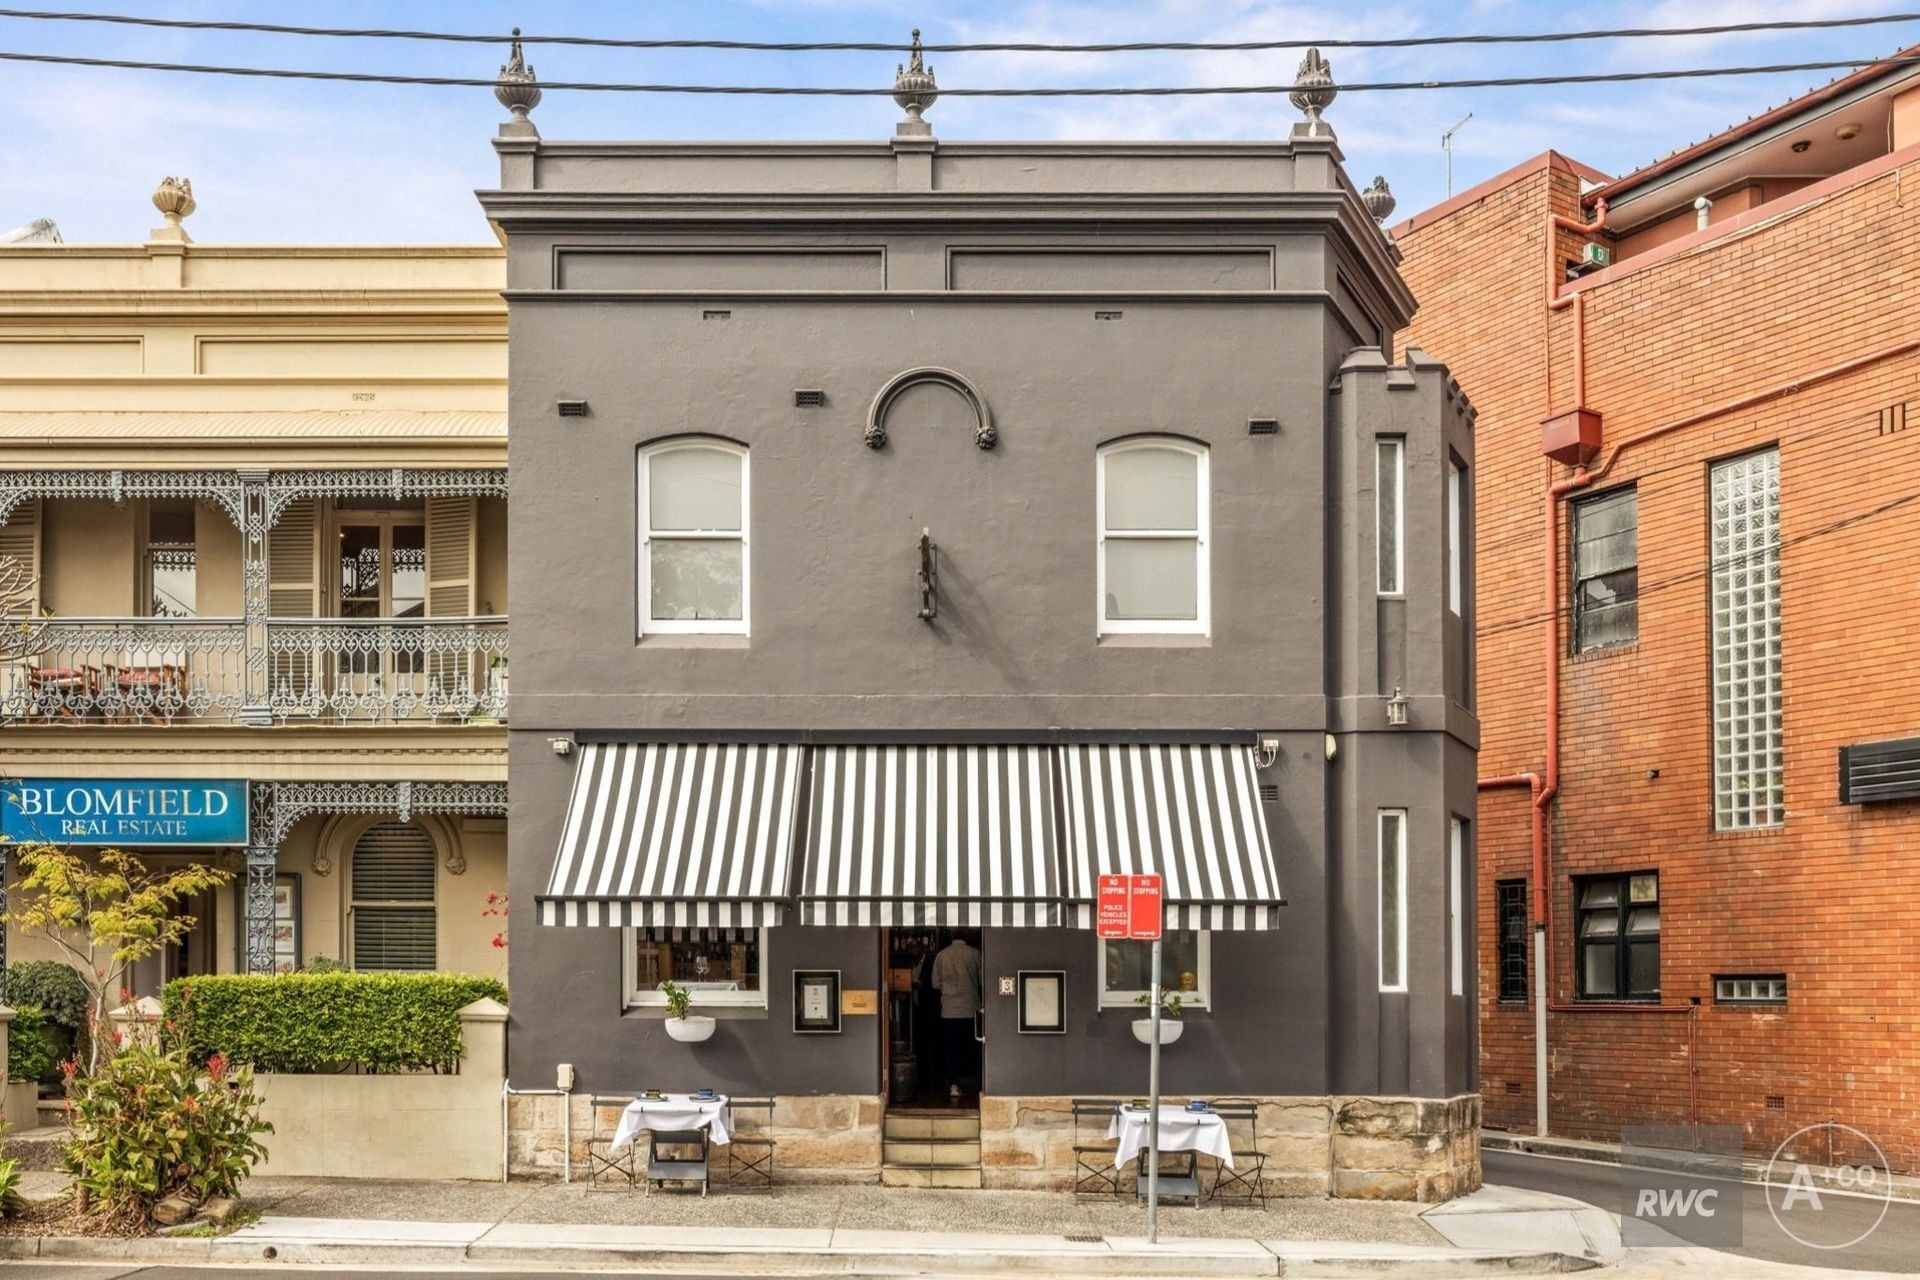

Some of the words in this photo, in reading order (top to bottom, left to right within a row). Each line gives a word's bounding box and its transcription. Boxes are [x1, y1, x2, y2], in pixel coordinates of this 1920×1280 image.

[19, 788, 229, 816] BLOMFIELD
[61, 819, 113, 836] REAL
[118, 819, 188, 836] ESTATE
[1102, 887, 1126, 895] STOPPING
[1133, 887, 1159, 895] STOPPING
